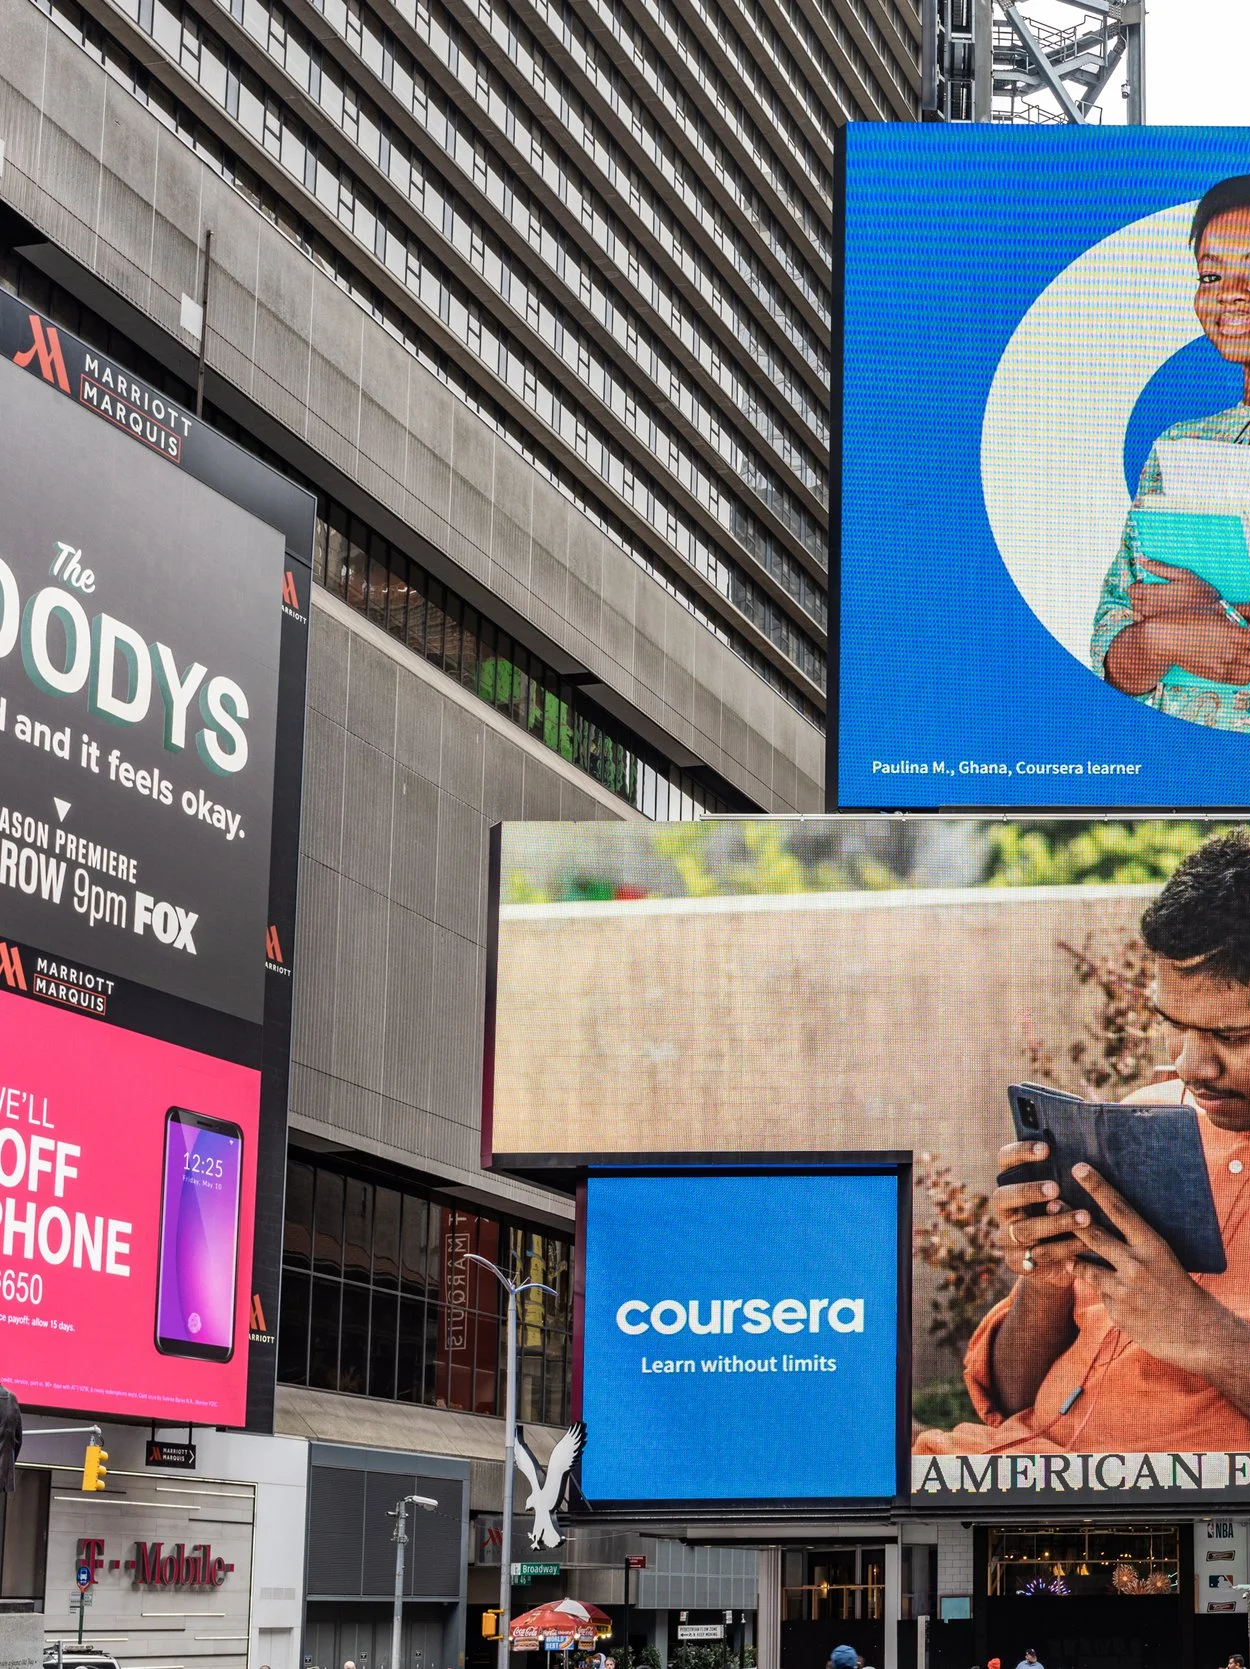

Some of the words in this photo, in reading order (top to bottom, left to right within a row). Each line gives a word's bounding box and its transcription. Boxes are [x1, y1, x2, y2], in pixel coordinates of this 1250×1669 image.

[85, 354, 191, 437] MARRIOTT
[84, 382, 178, 456] MARQUIS
[57, 541, 95, 593] The
[281, 605, 307, 625] ARRIOTT
[15, 714, 71, 760] and
[81, 733, 100, 774] it
[108, 750, 173, 805] feels
[181, 790, 245, 841] okay.
[872, 761, 928, 774] Paulina
[932, 761, 955, 777] M.,
[959, 761, 1012, 777] Ghana,
[1016, 762, 1083, 775] Coursera
[1088, 762, 1141, 775] learner
[55, 829, 138, 884] PREMIERE
[74, 868, 127, 927] 9pm
[134, 890, 199, 955] FOX
[37, 957, 115, 995] MARRIOTT
[265, 961, 291, 977] ARRIOTT
[36, 978, 104, 1012] MARQUIS
[0, 1128, 81, 1197] OFF
[184, 1152, 223, 1178] 12:25
[0, 1197, 132, 1277] HONE
[0, 1269, 43, 1305] 650
[31, 1317, 48, 1328] allow
[50, 1320, 58, 1329] 15
[58, 1321, 75, 1332] days.
[616, 1298, 864, 1335] coursera
[248, 1333, 275, 1344] ARRIOTT
[641, 1357, 695, 1373] Learn
[701, 1356, 777, 1373] without
[782, 1355, 836, 1371] limits
[920, 1453, 1206, 1492] AMERICAN
[1216, 1523, 1234, 1538] NBA
[520, 1576, 526, 1584] 46
[522, 1564, 558, 1574] Broadway
